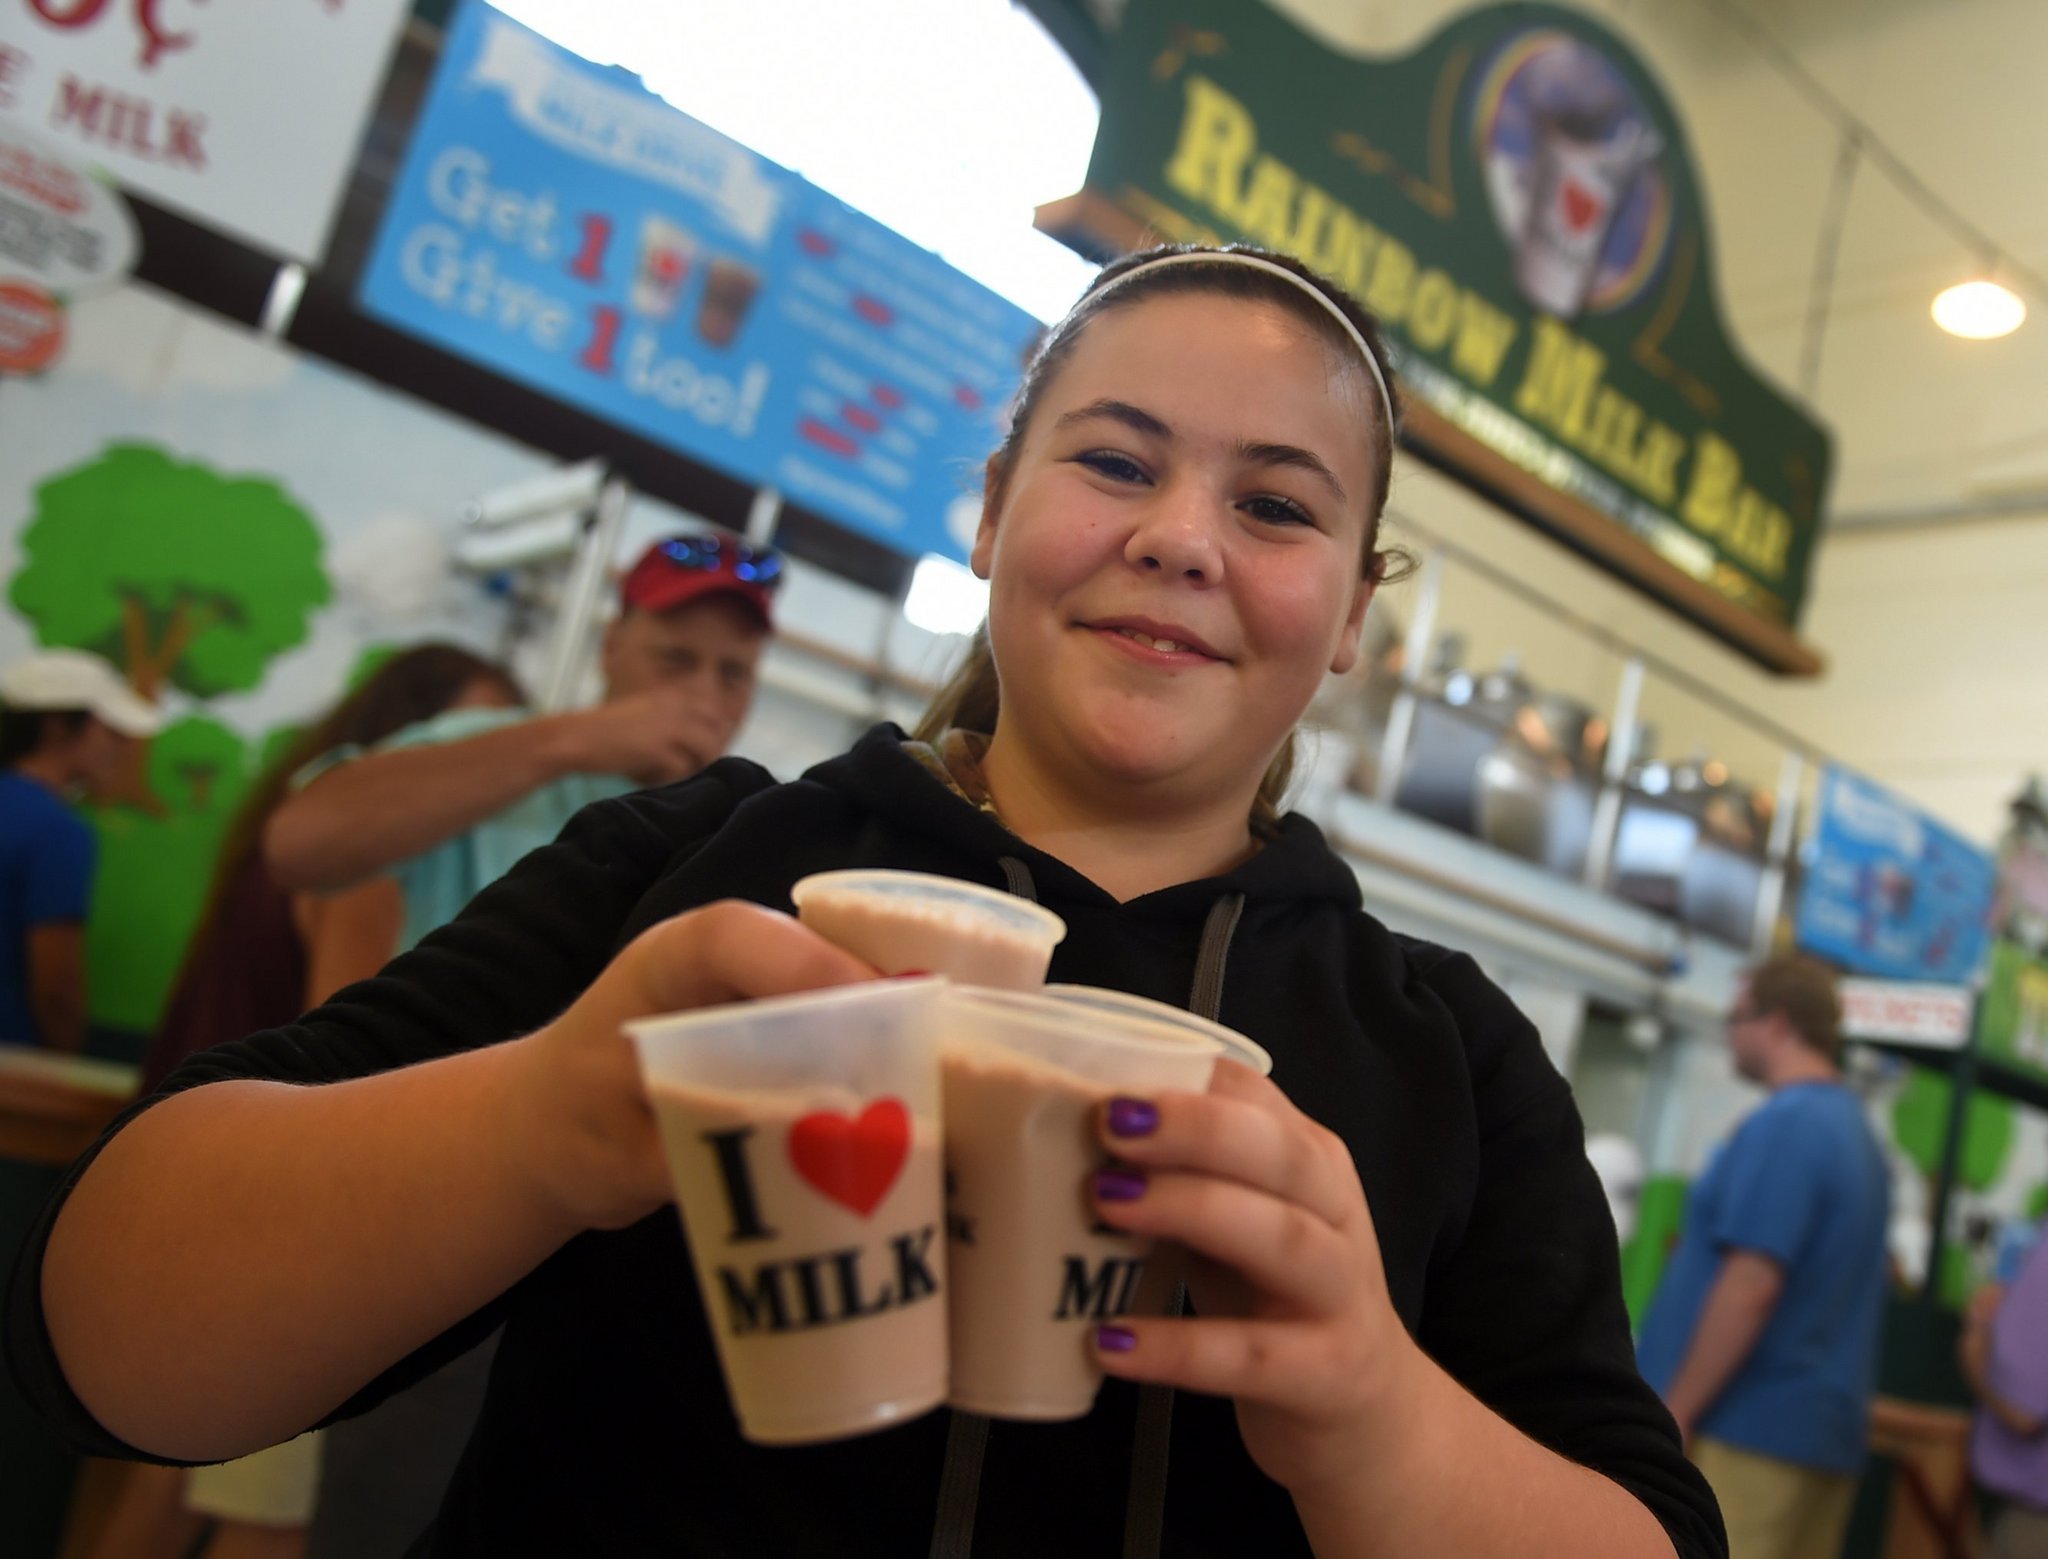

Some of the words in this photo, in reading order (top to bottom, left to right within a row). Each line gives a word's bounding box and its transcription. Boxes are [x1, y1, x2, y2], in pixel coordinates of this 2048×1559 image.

[50, 72, 208, 173] MILK
[427, 145, 560, 260] Get
[565, 211, 614, 287] 1
[402, 221, 570, 350] Give
[572, 305, 623, 379] 1
[624, 326, 772, 438] too!
[1165, 74, 1516, 387] RAINBOW
[1514, 318, 1686, 498] MILK
[1682, 430, 1793, 582] BAR
[698, 1127, 776, 1246] I
[715, 1225, 940, 1337] MILK
